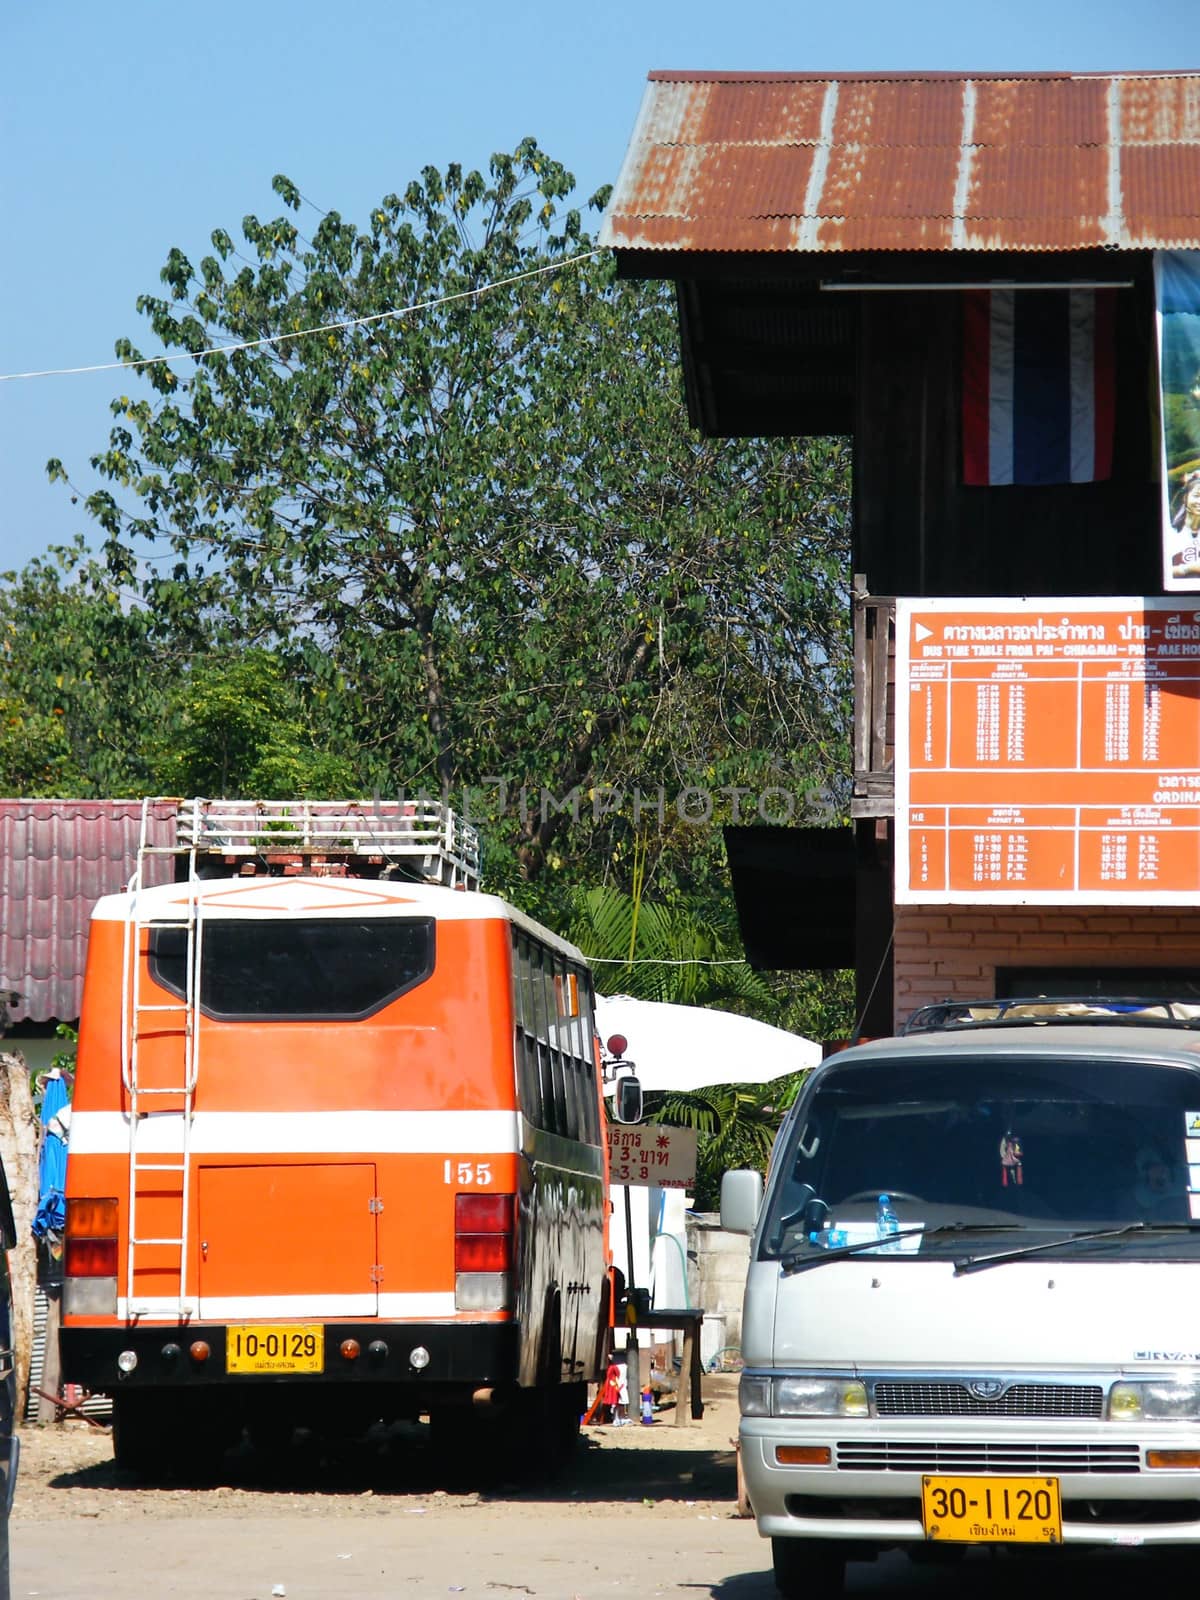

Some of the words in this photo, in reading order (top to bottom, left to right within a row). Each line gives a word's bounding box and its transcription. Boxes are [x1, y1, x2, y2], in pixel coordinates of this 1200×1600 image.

[923, 644, 943, 657] BUS
[944, 644, 970, 657] TIME
[971, 644, 1003, 657] TABLE
[1005, 644, 1034, 657] FROM
[1182, 645, 1200, 656] HO
[443, 1159, 492, 1185] 155
[236, 1333, 316, 1358] 10-0129
[931, 1487, 1052, 1521] 30-1120
[969, 1523, 1017, 1538] เชียงใหม่
